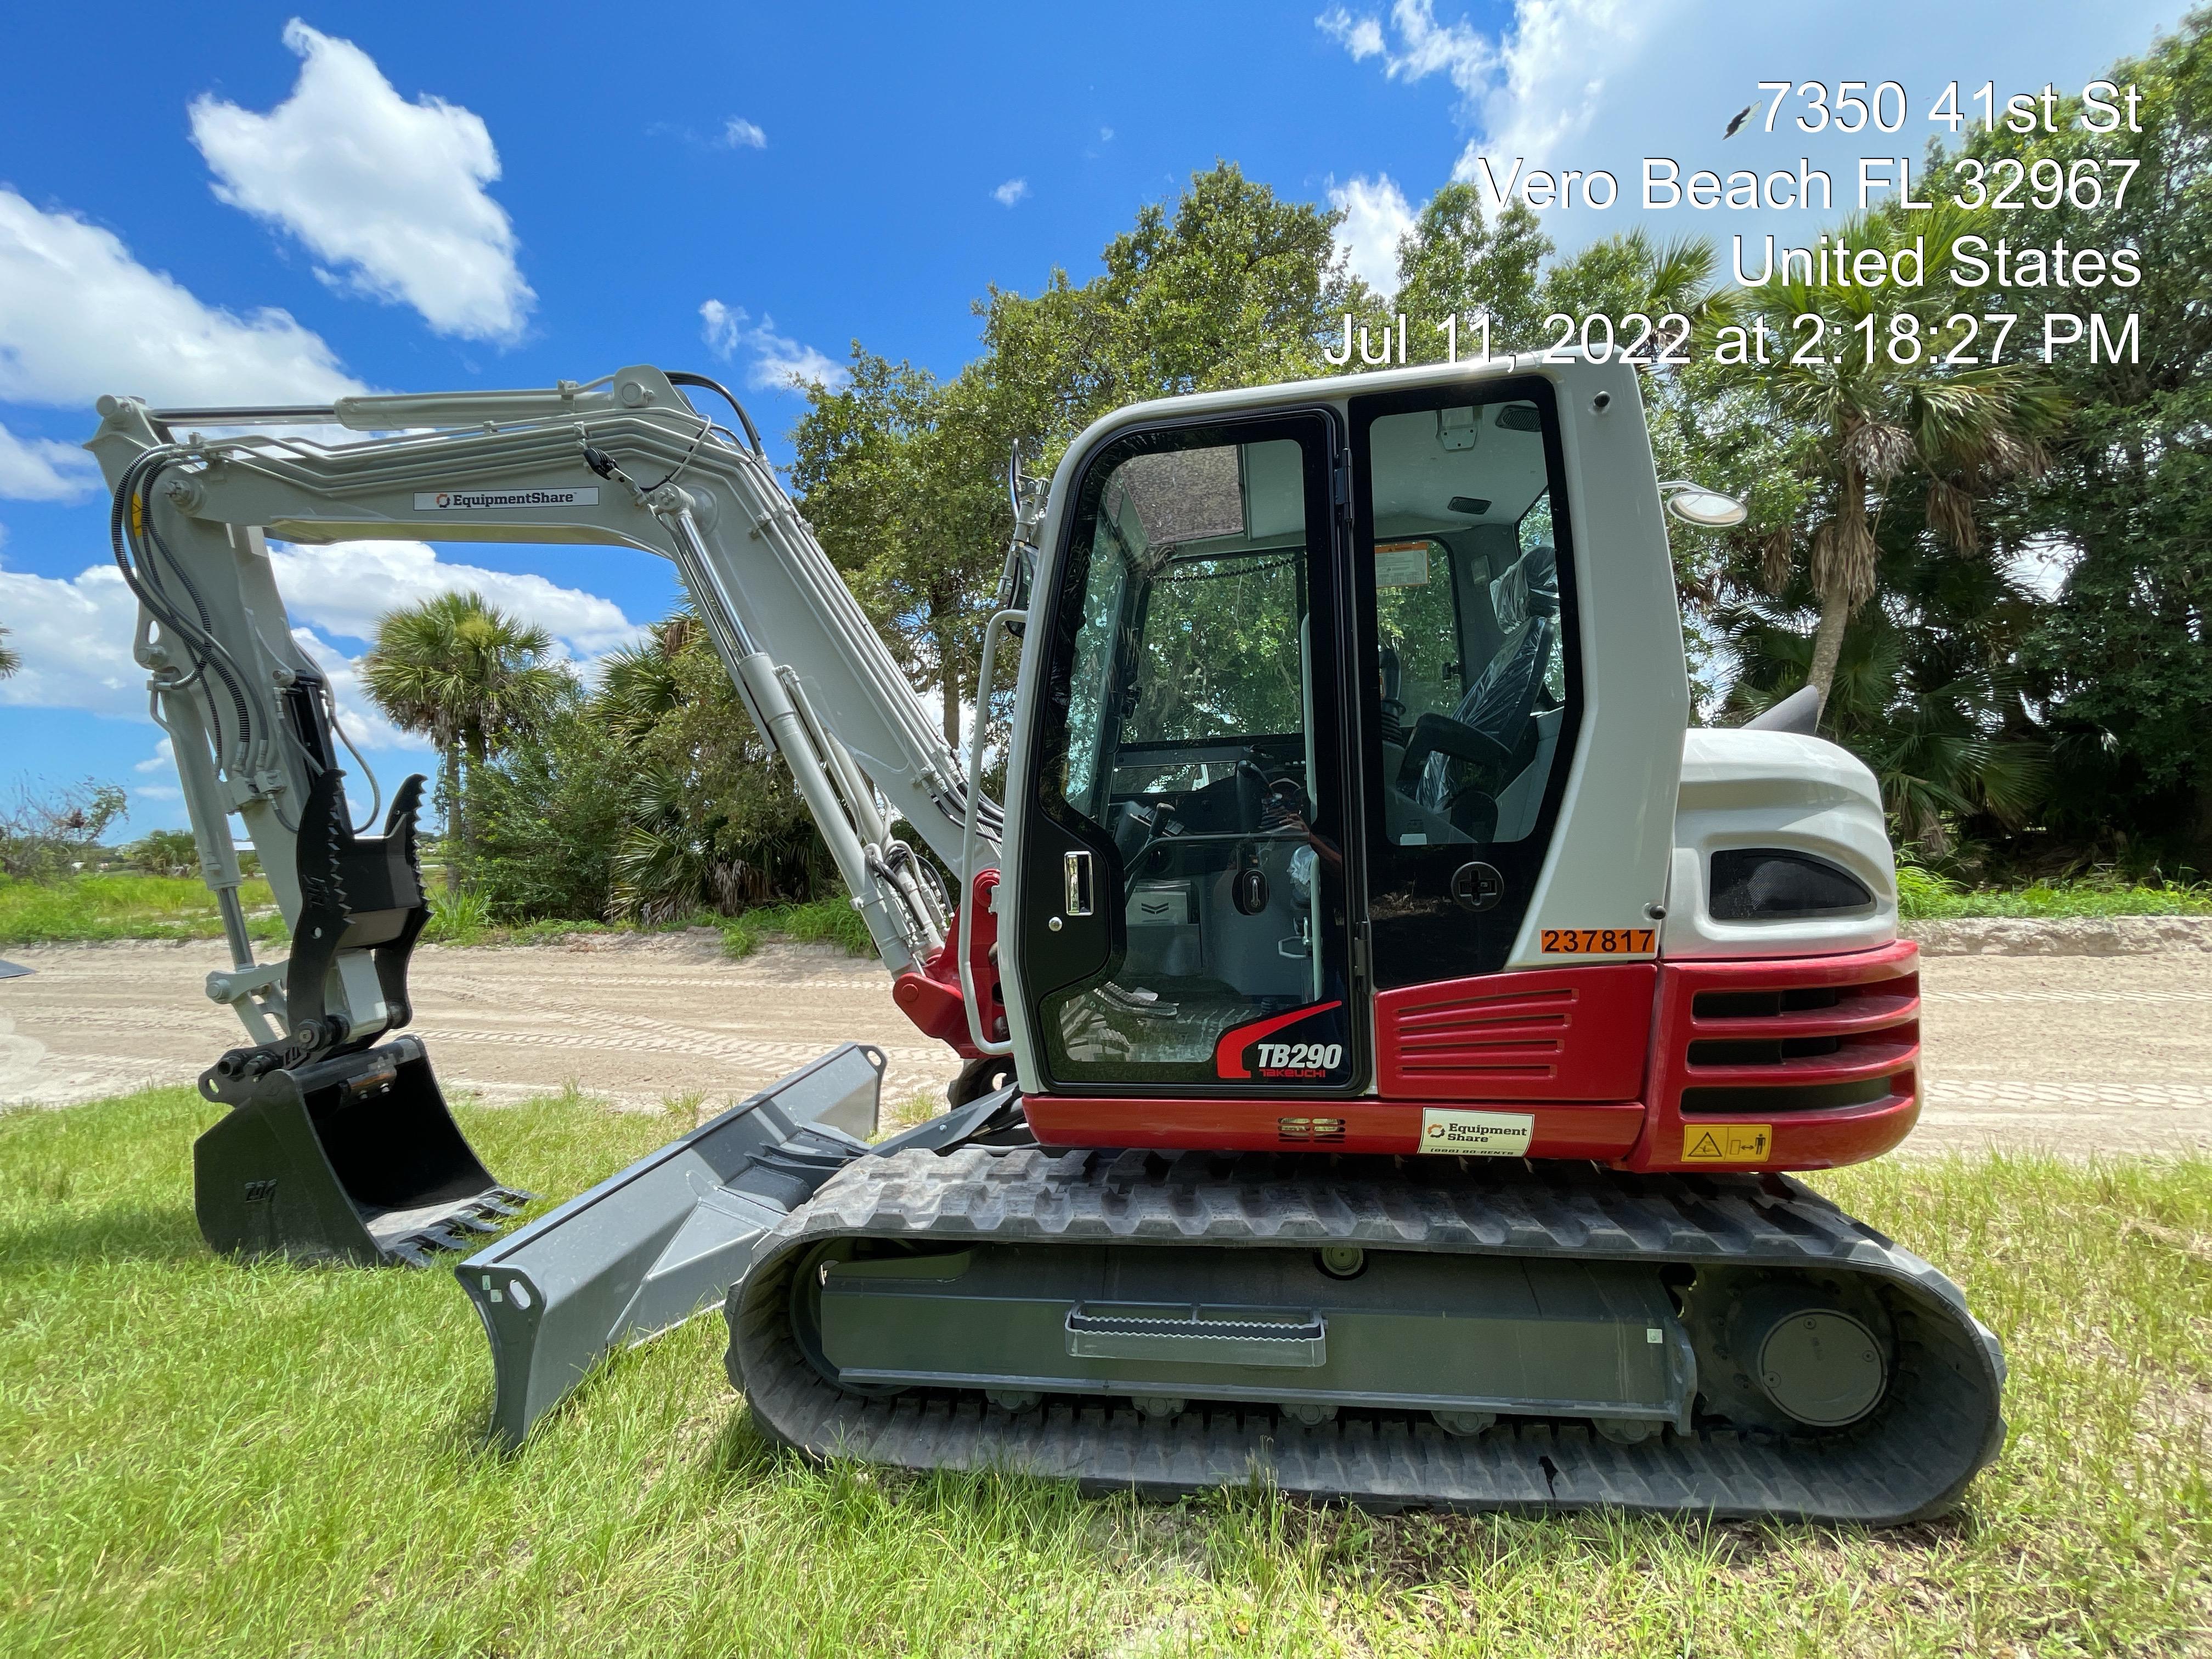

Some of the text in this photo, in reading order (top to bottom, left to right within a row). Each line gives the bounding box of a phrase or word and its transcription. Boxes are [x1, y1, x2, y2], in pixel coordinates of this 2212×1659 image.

[453, 492, 574, 507] EquipmentShare
[1544, 929, 1654, 952] 237817
[1258, 1043, 1342, 1069] TB290
[1449, 1123, 1528, 1136] Equipment
[1447, 1133, 1489, 1142] Share
